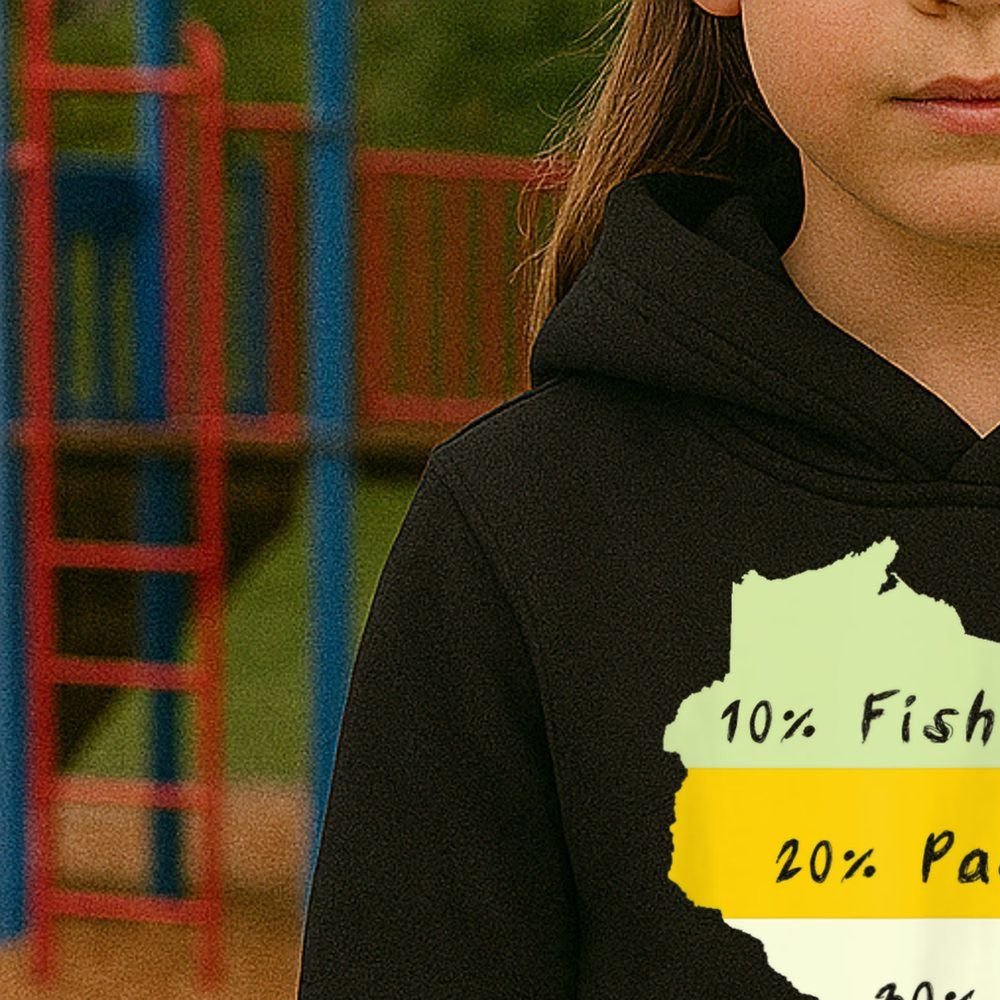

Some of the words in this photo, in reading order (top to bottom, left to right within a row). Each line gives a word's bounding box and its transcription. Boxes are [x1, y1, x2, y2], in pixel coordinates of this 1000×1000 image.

[720, 699, 816, 744] 10%
[861, 688, 996, 746] Fish
[775, 837, 876, 884] 20%
